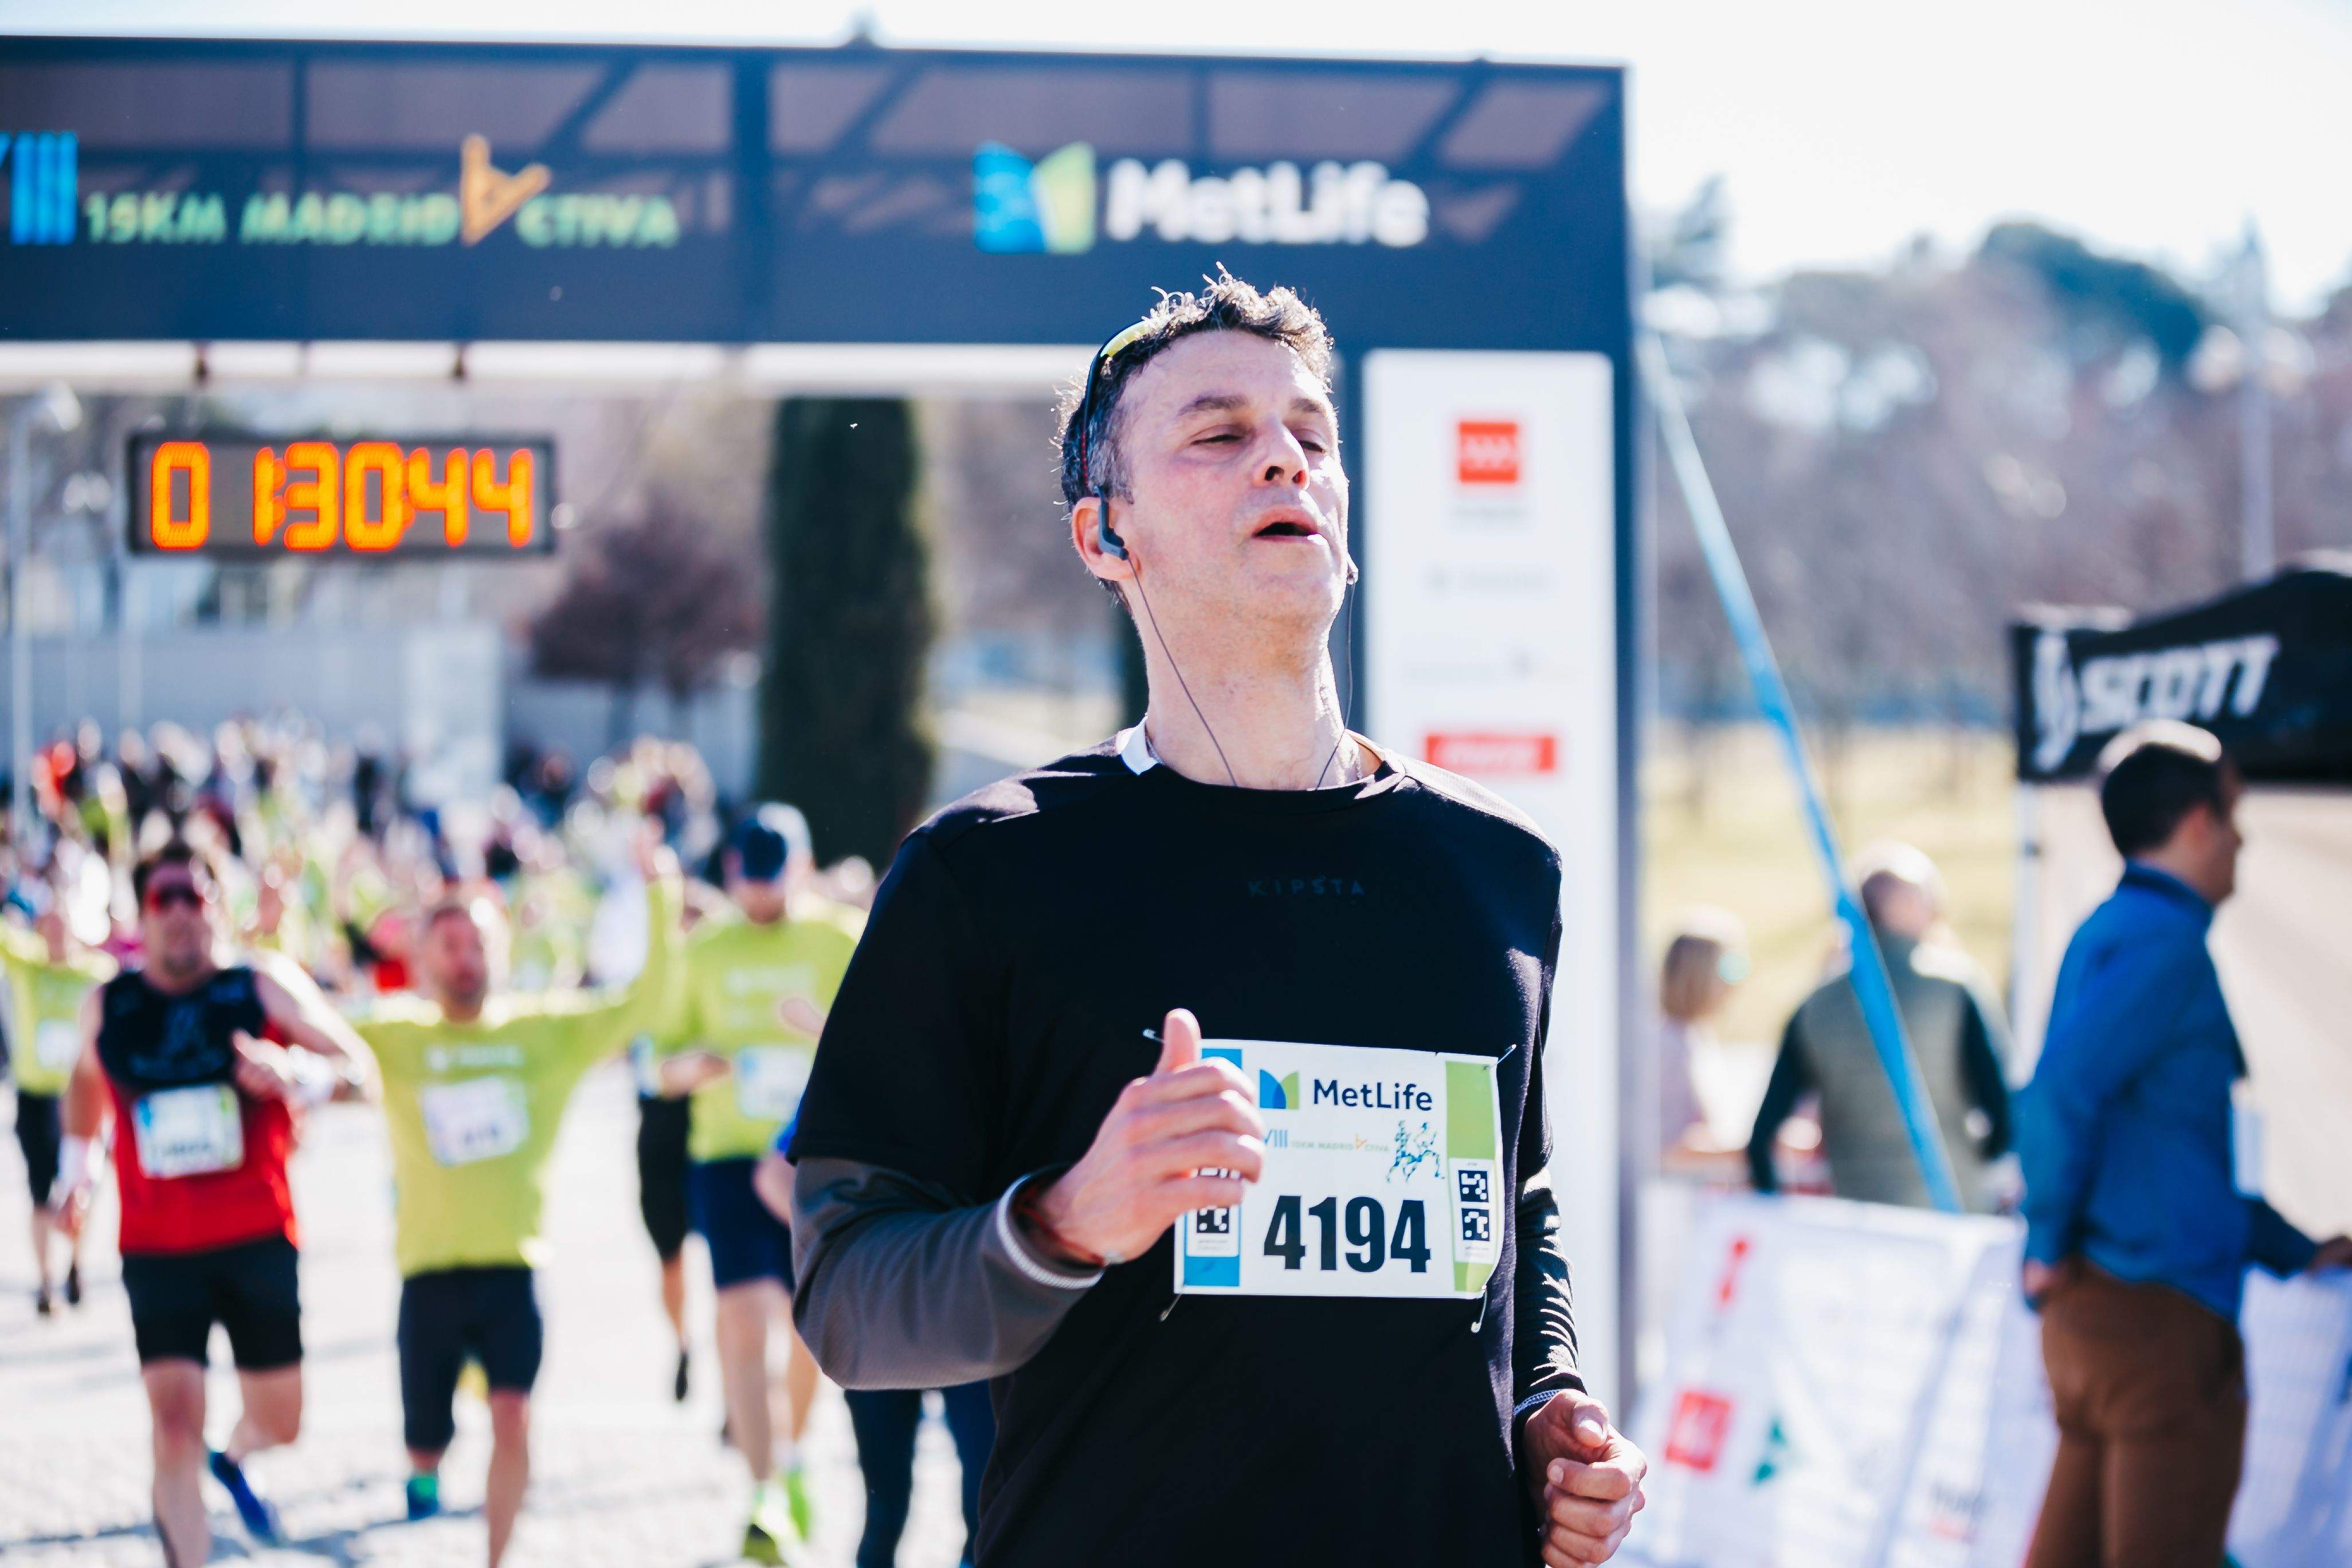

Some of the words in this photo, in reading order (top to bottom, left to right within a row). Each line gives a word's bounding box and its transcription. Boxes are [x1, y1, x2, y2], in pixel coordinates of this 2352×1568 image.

[0, 131, 77, 245] III
[1107, 158, 1429, 246] MetLife
[2079, 633, 2282, 735] SCOTT
[1248, 877, 1366, 898] KIPSTA
[1313, 1079, 1433, 1111] MetLife
[1263, 1194, 1432, 1273] 4194
